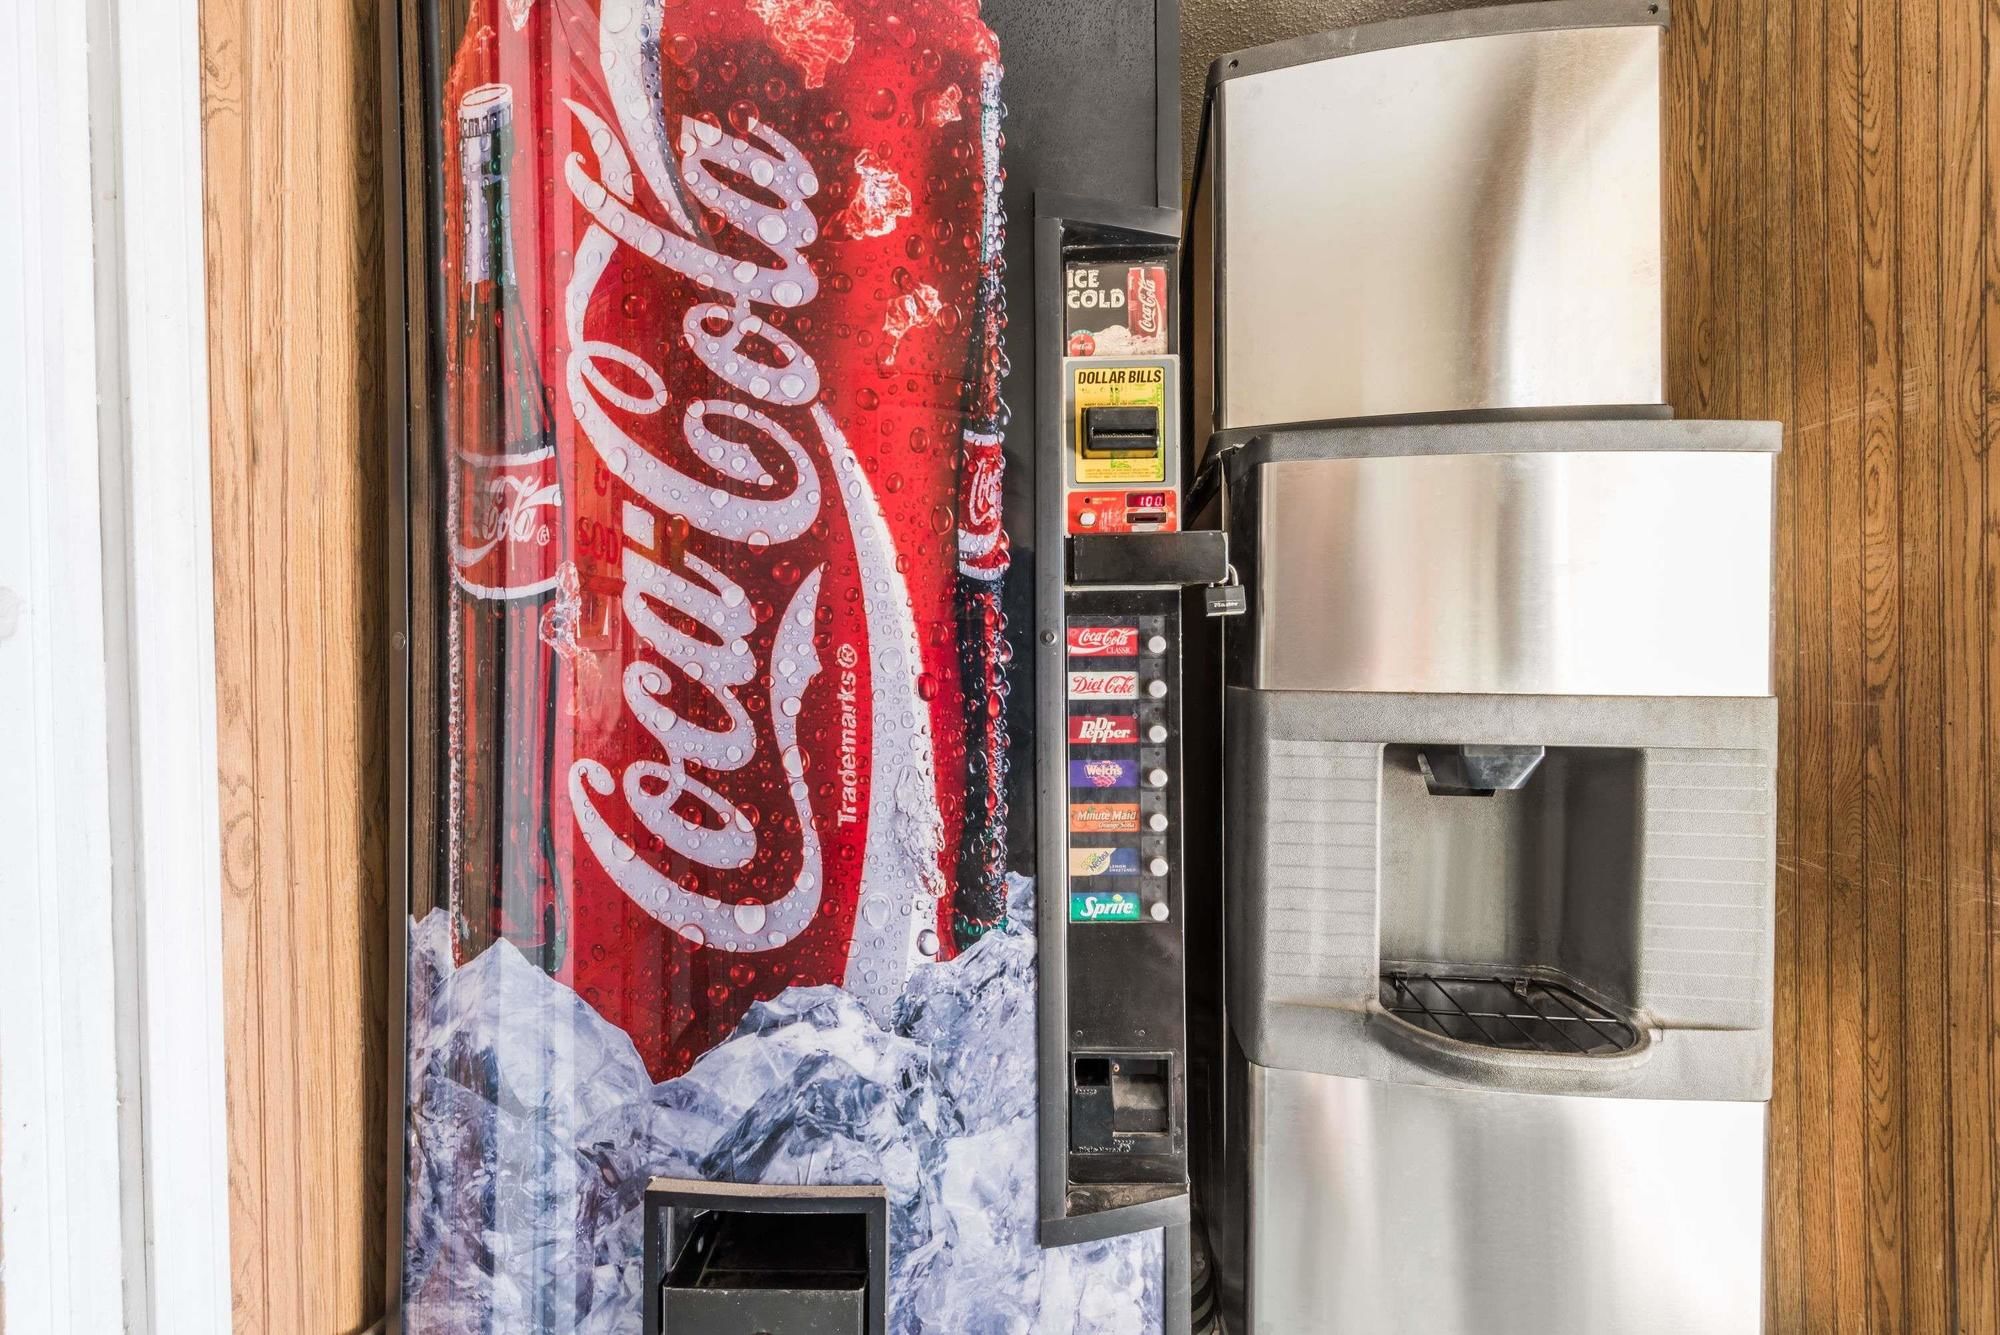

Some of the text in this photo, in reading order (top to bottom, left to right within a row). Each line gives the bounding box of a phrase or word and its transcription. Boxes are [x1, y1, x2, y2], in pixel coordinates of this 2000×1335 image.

[1067, 269, 1100, 288] ICE
[1067, 289, 1125, 308] COLD
[1078, 370, 1162, 385] DOLLAR BILLS
[565, 98, 823, 953] Coca-Cola
[1071, 675, 1136, 693] Diet Coke
[1078, 720, 1131, 743] Pepper
[1096, 717, 1116, 731] Dr
[1077, 810, 1137, 821] Minute Maid
[1080, 896, 1134, 919] Sprite
